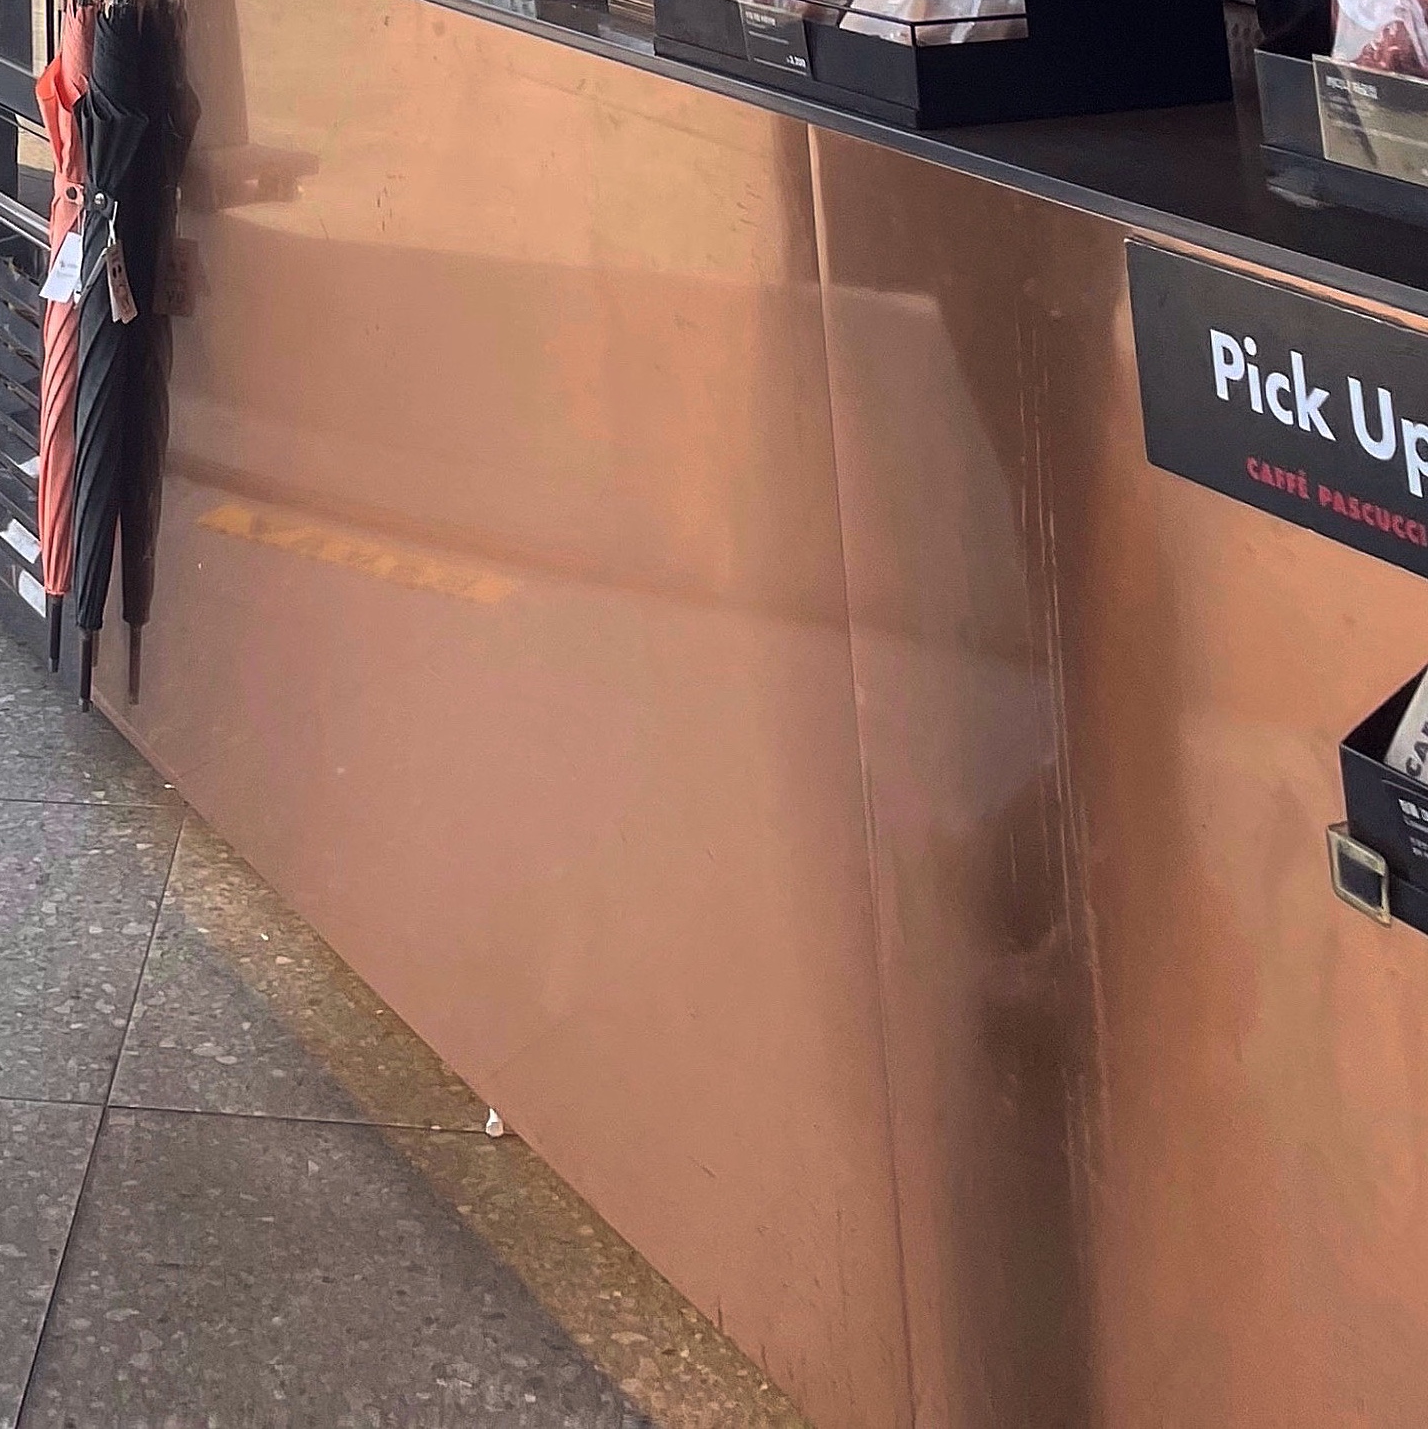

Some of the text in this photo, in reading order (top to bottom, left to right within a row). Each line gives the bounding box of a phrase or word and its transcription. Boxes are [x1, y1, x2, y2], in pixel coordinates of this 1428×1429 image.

[1209, 328, 1428, 498] Pick Up
[1317, 484, 1428, 547] PASCUCCI
